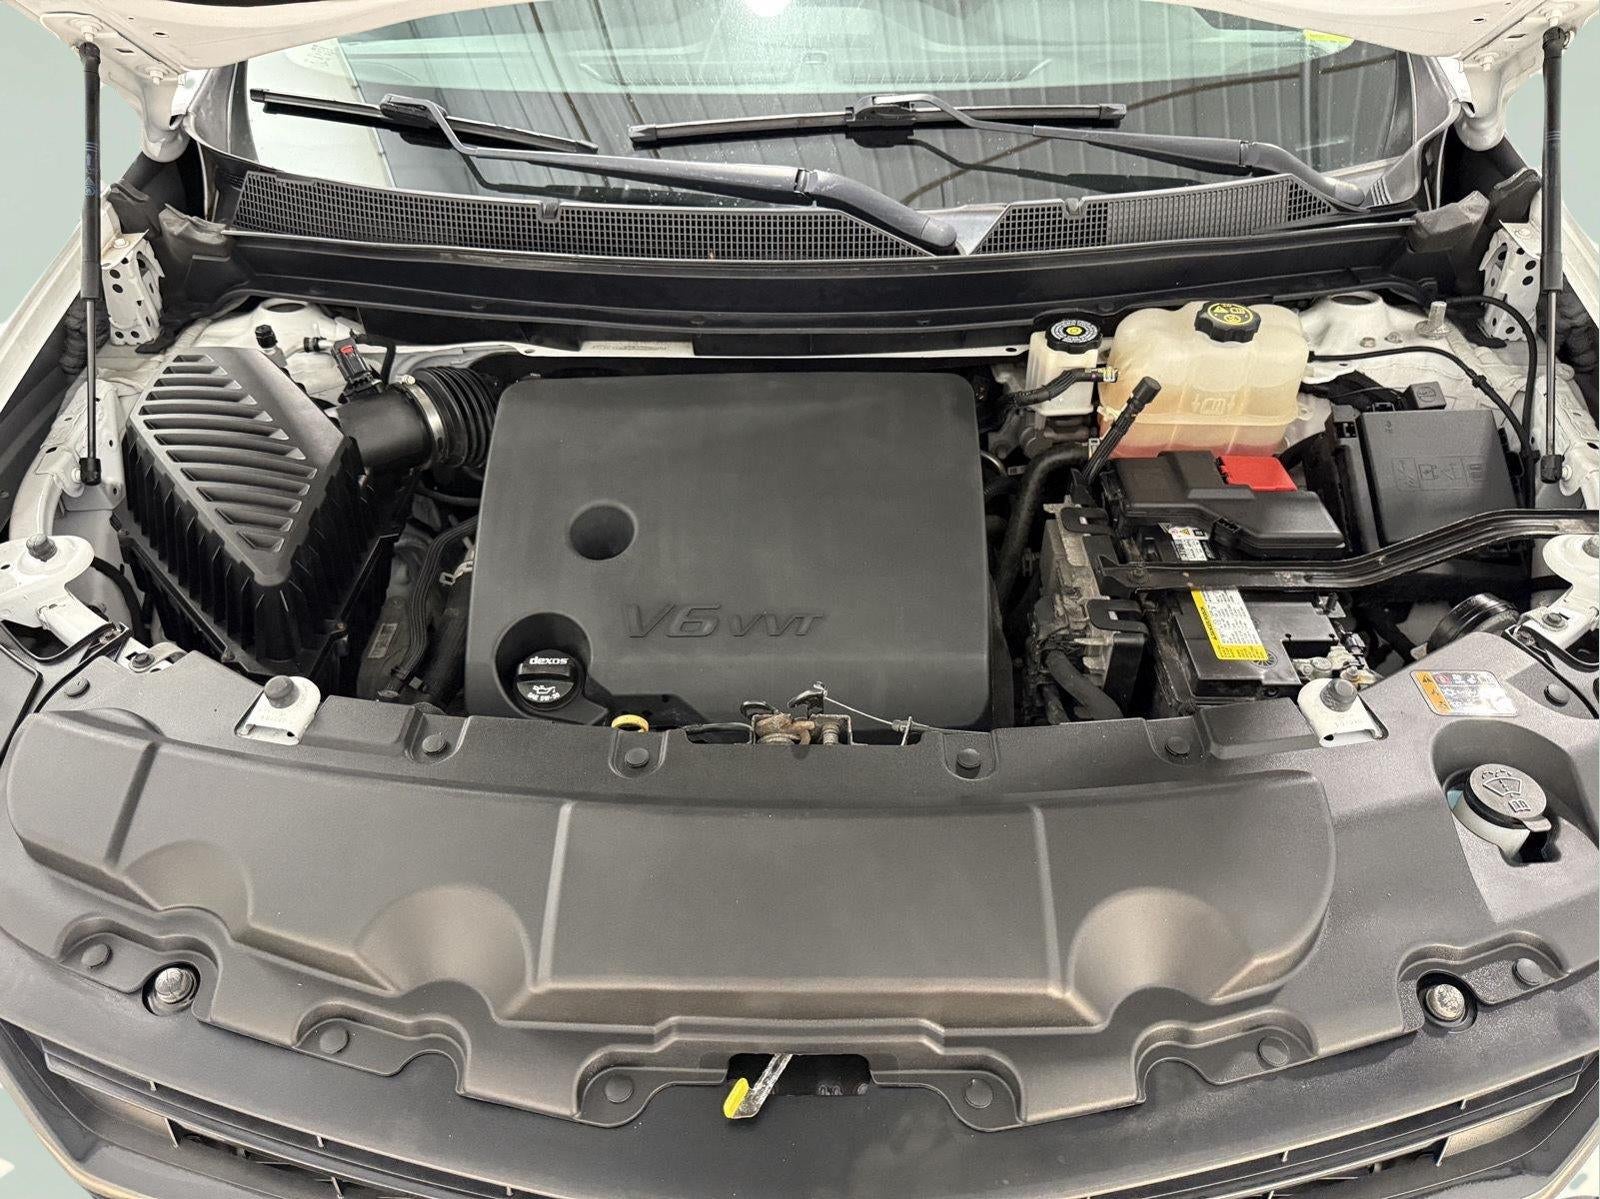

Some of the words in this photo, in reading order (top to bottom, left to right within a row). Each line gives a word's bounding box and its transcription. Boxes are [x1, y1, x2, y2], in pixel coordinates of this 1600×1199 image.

[621, 603, 722, 638] V6
[727, 608, 824, 638] VVT
[529, 656, 569, 665] dexos
